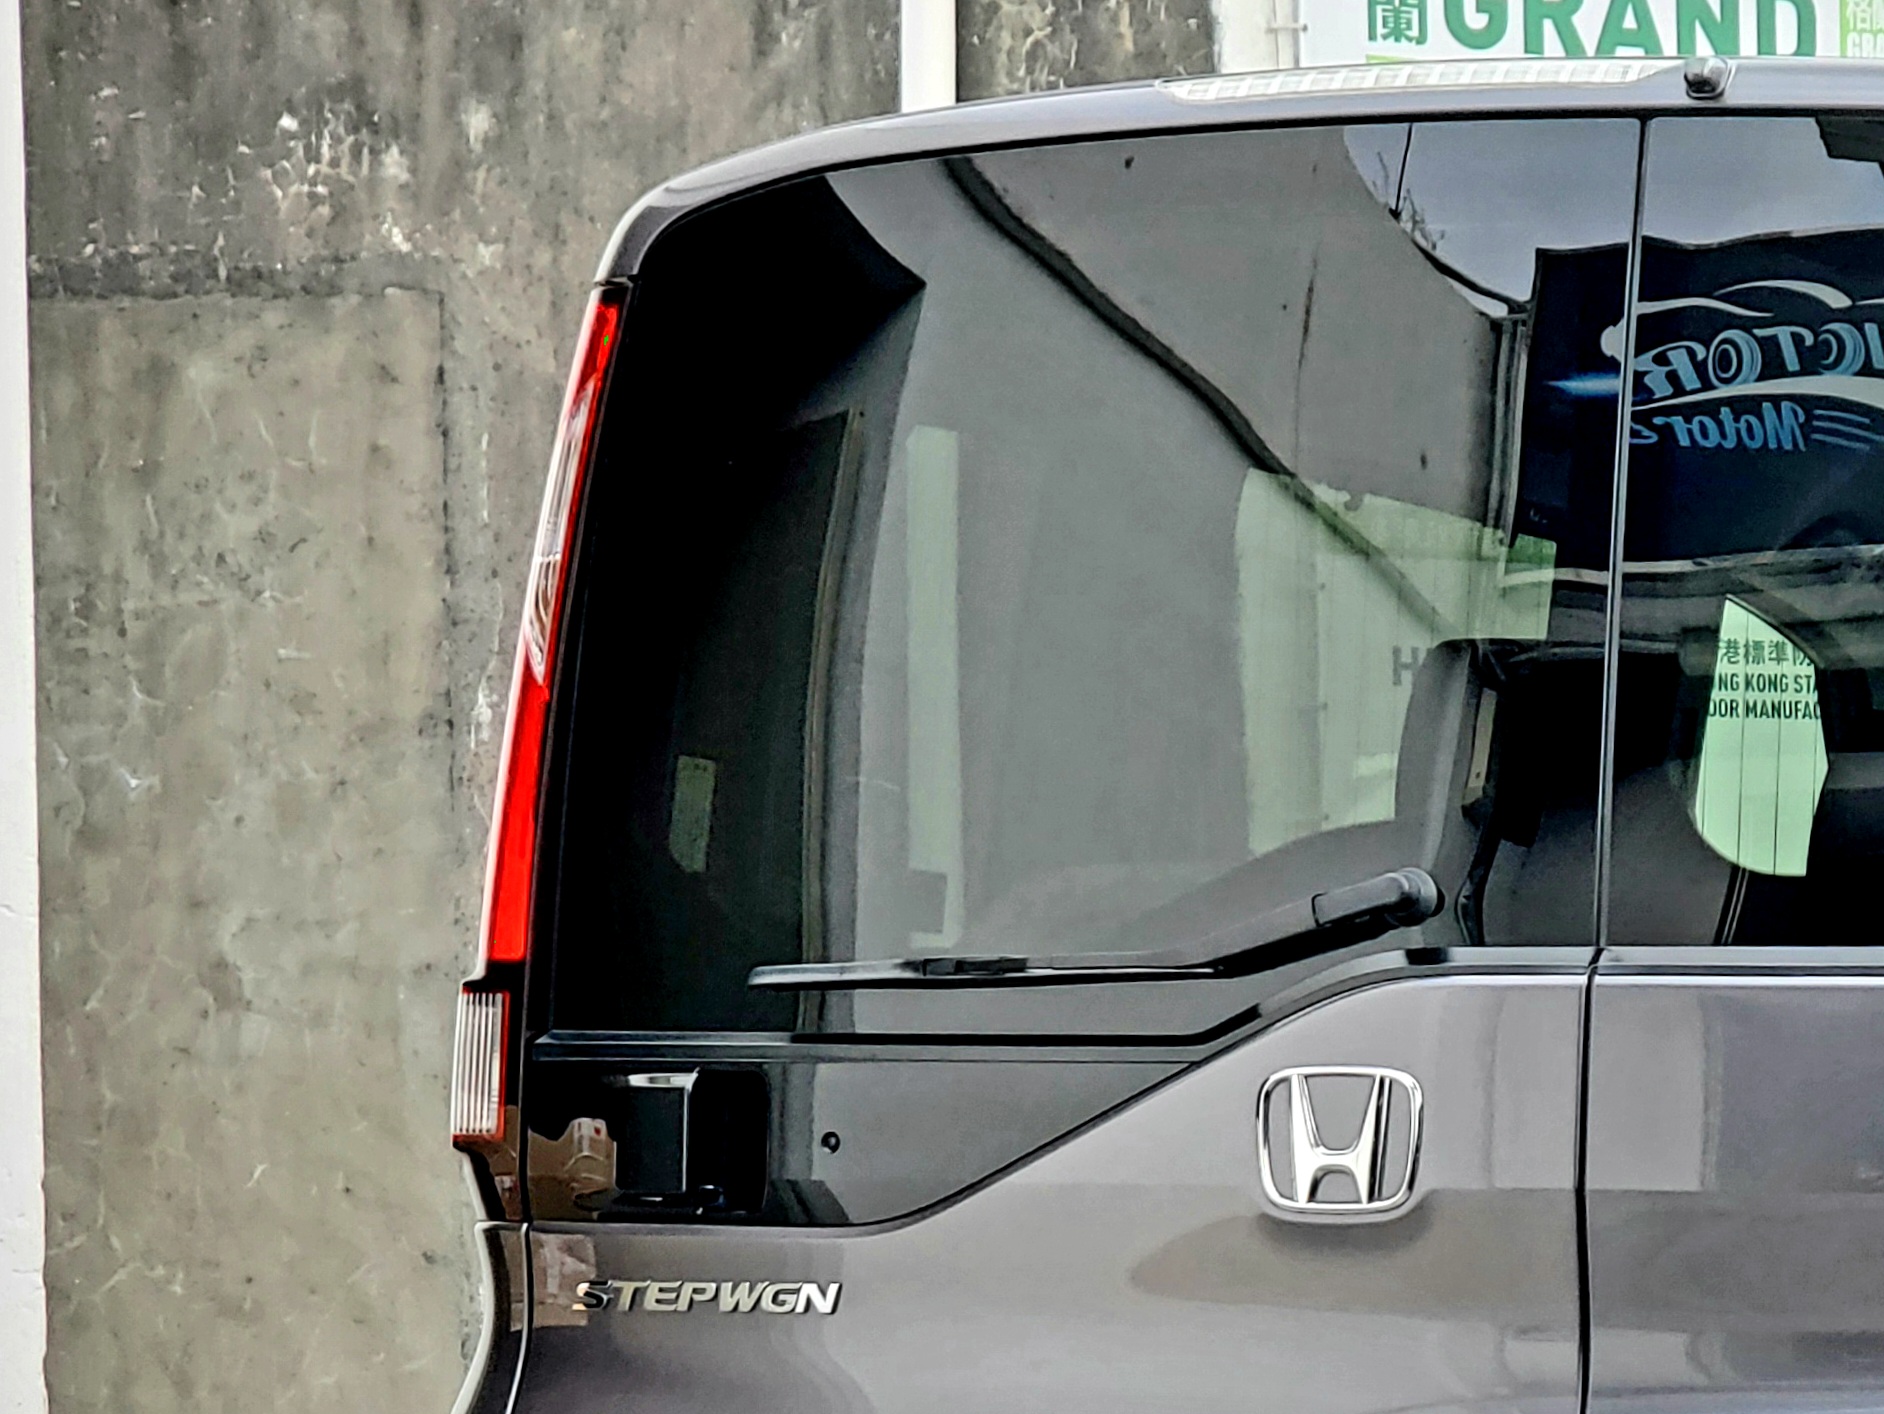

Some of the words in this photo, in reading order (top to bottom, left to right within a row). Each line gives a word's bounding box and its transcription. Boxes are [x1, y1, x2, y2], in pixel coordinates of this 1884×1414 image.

[1444, 0, 1817, 58] GRAND
[1745, 673, 1789, 693] KONG
[572, 1279, 843, 1315] STEPWGN
